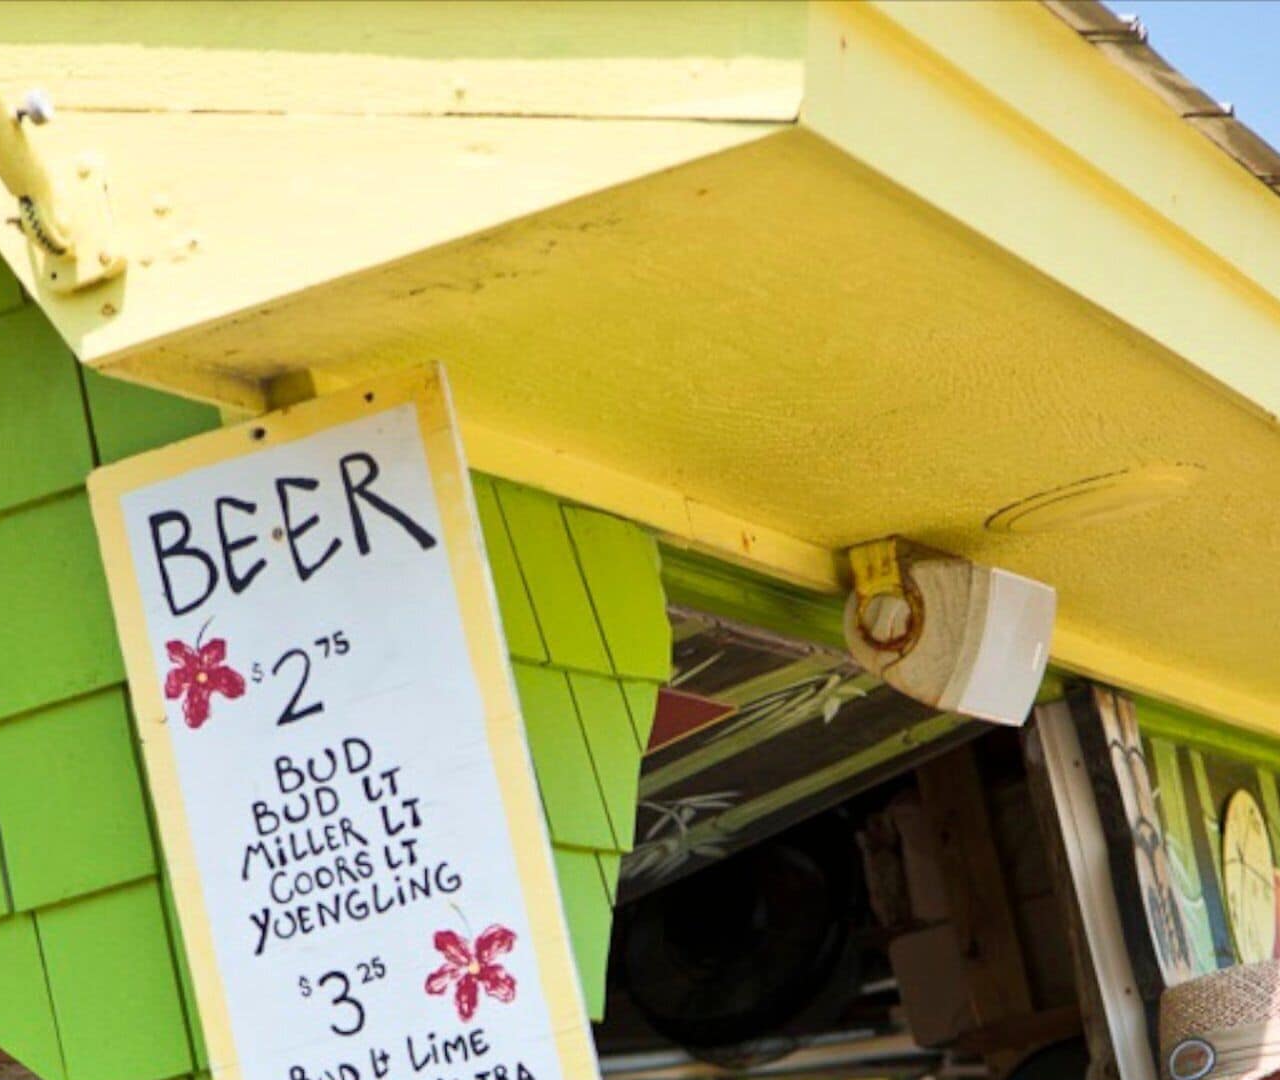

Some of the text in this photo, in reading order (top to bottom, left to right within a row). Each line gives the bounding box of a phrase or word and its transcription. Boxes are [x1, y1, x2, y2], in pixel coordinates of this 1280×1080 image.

[149, 453, 436, 616] BEER
[276, 738, 372, 794] BUD
[252, 768, 401, 835] BUD LT
[382, 798, 422, 837] LT
[269, 838, 420, 904] COORS LT
